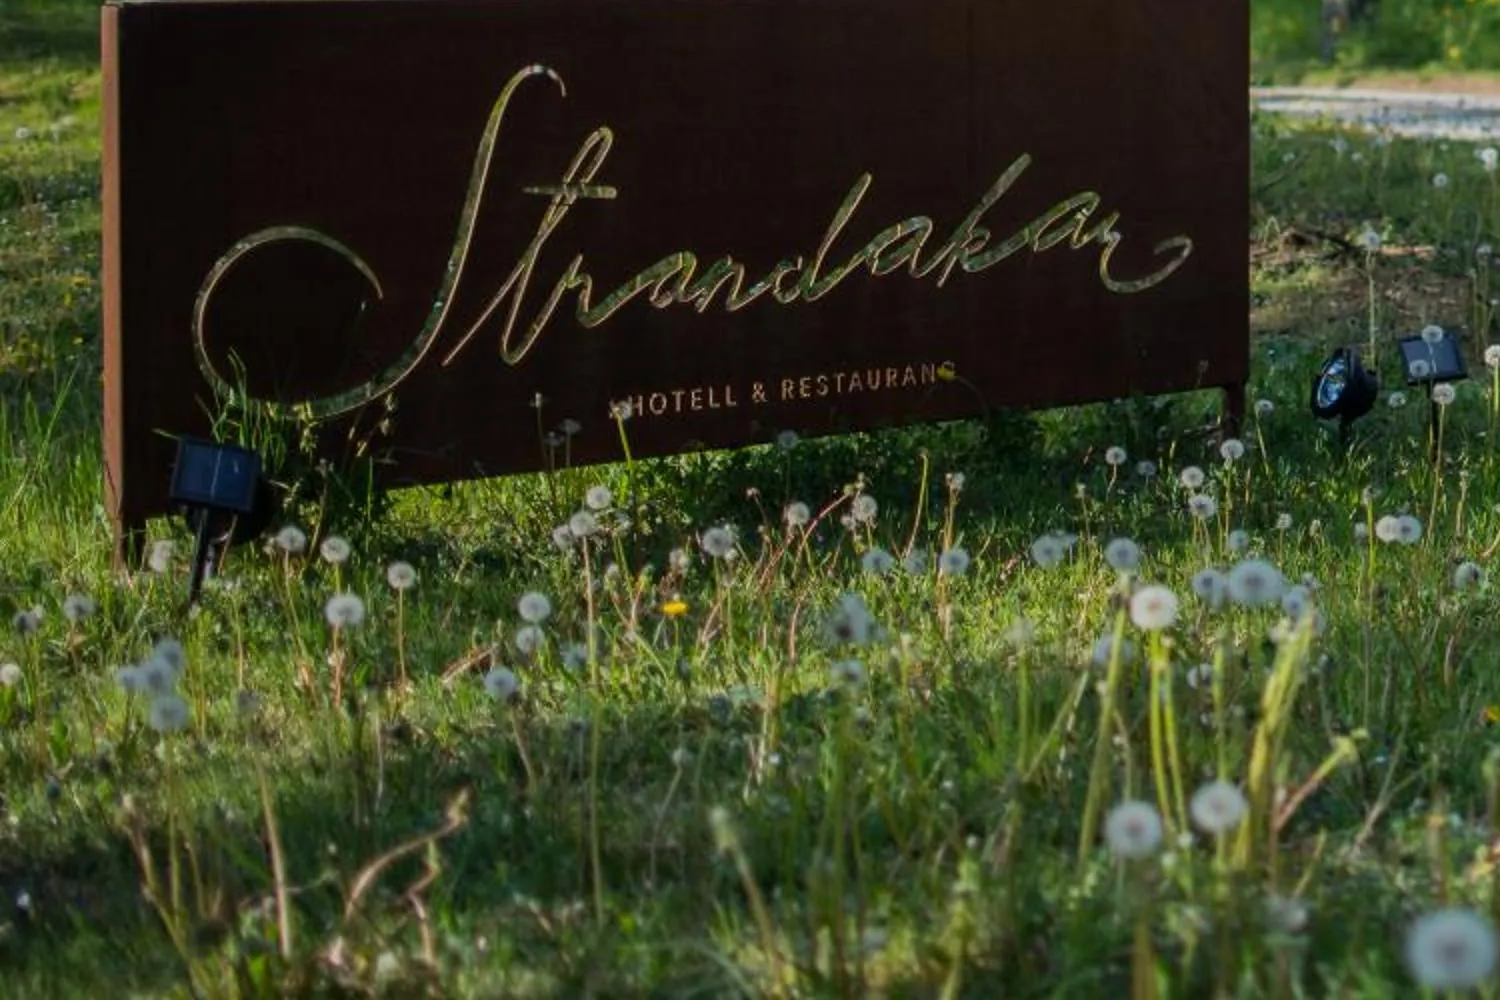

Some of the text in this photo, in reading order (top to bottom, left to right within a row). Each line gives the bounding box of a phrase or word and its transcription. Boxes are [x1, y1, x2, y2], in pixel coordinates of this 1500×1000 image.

[192, 63, 1192, 421] Strandakar
[627, 384, 737, 417] HOTELL
[751, 381, 768, 403] &
